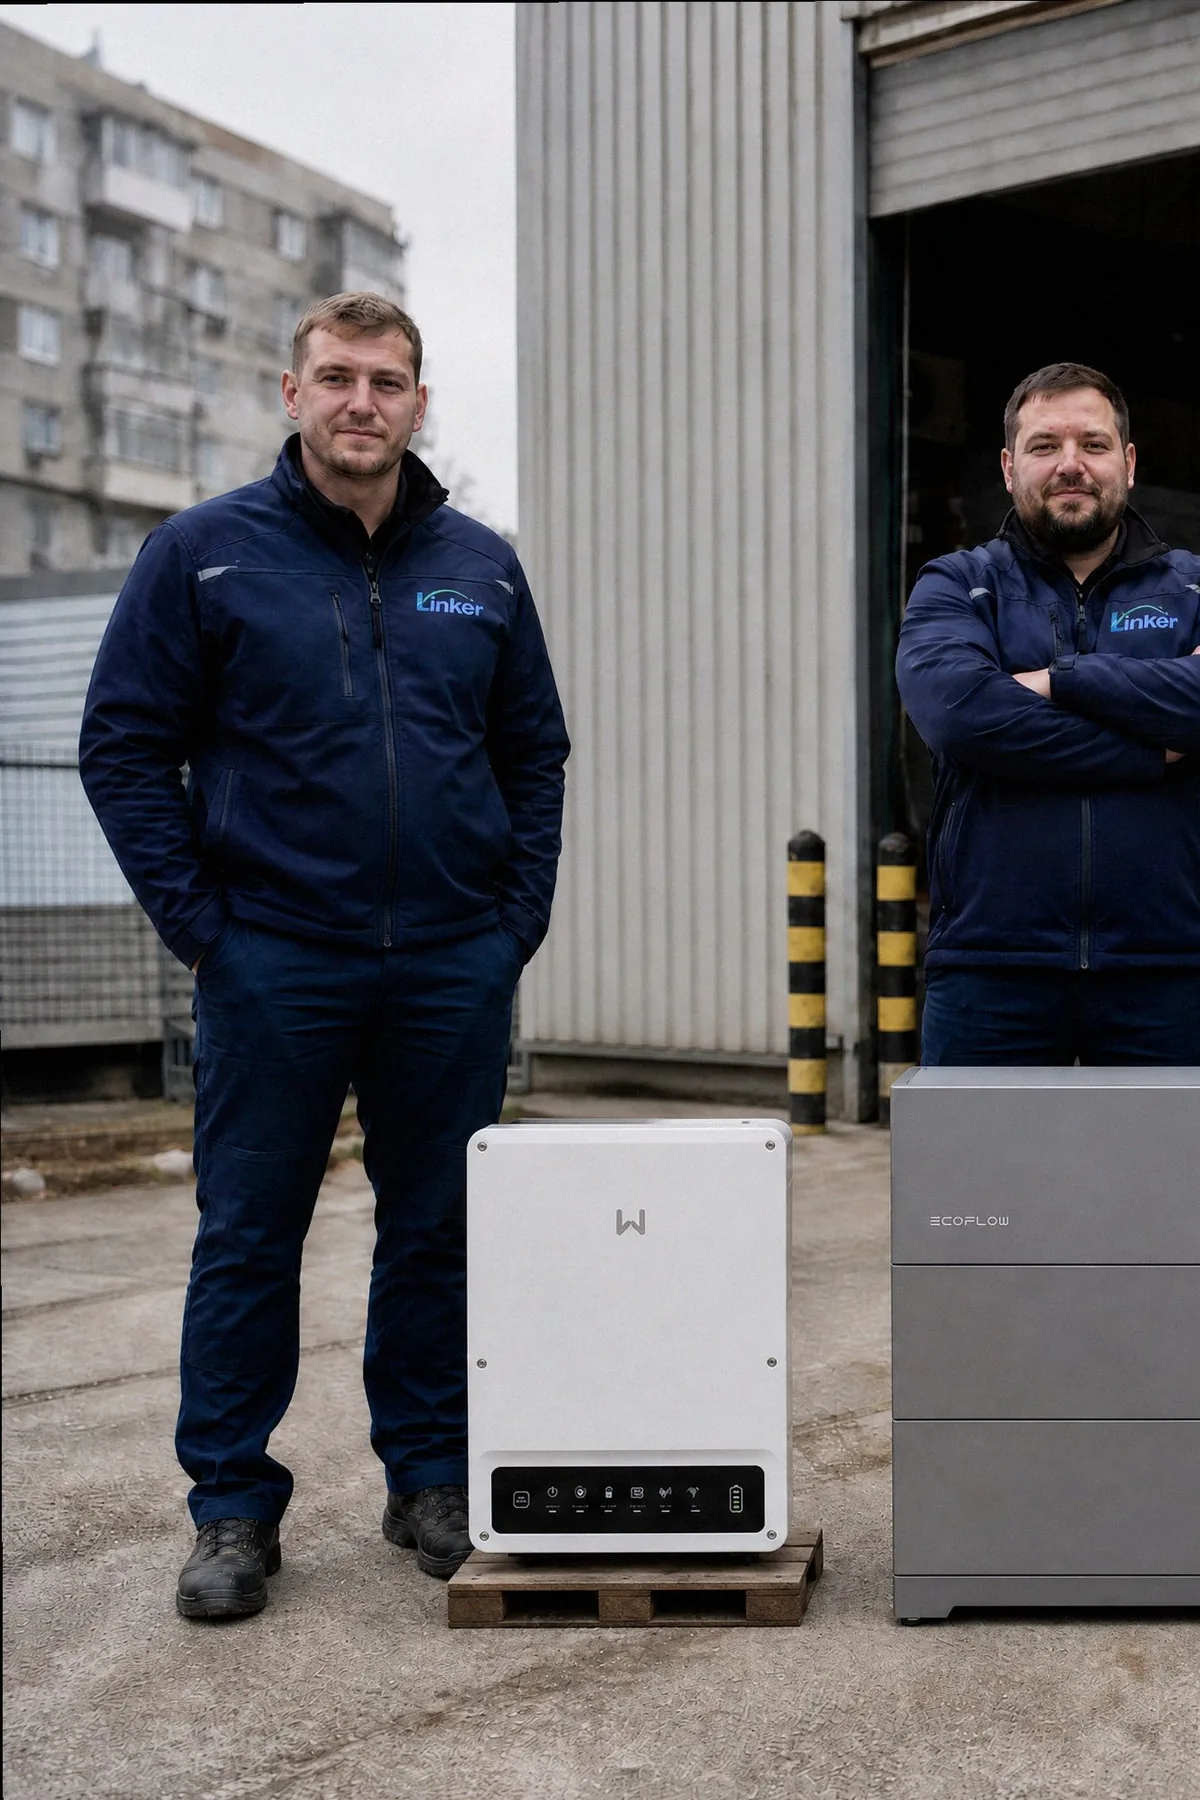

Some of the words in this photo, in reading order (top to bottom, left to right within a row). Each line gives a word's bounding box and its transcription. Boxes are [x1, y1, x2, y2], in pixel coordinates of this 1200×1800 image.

[416, 591, 484, 616] Linker
[1110, 611, 1179, 633] Linker
[929, 1215, 1010, 1227] ECOFLOW
